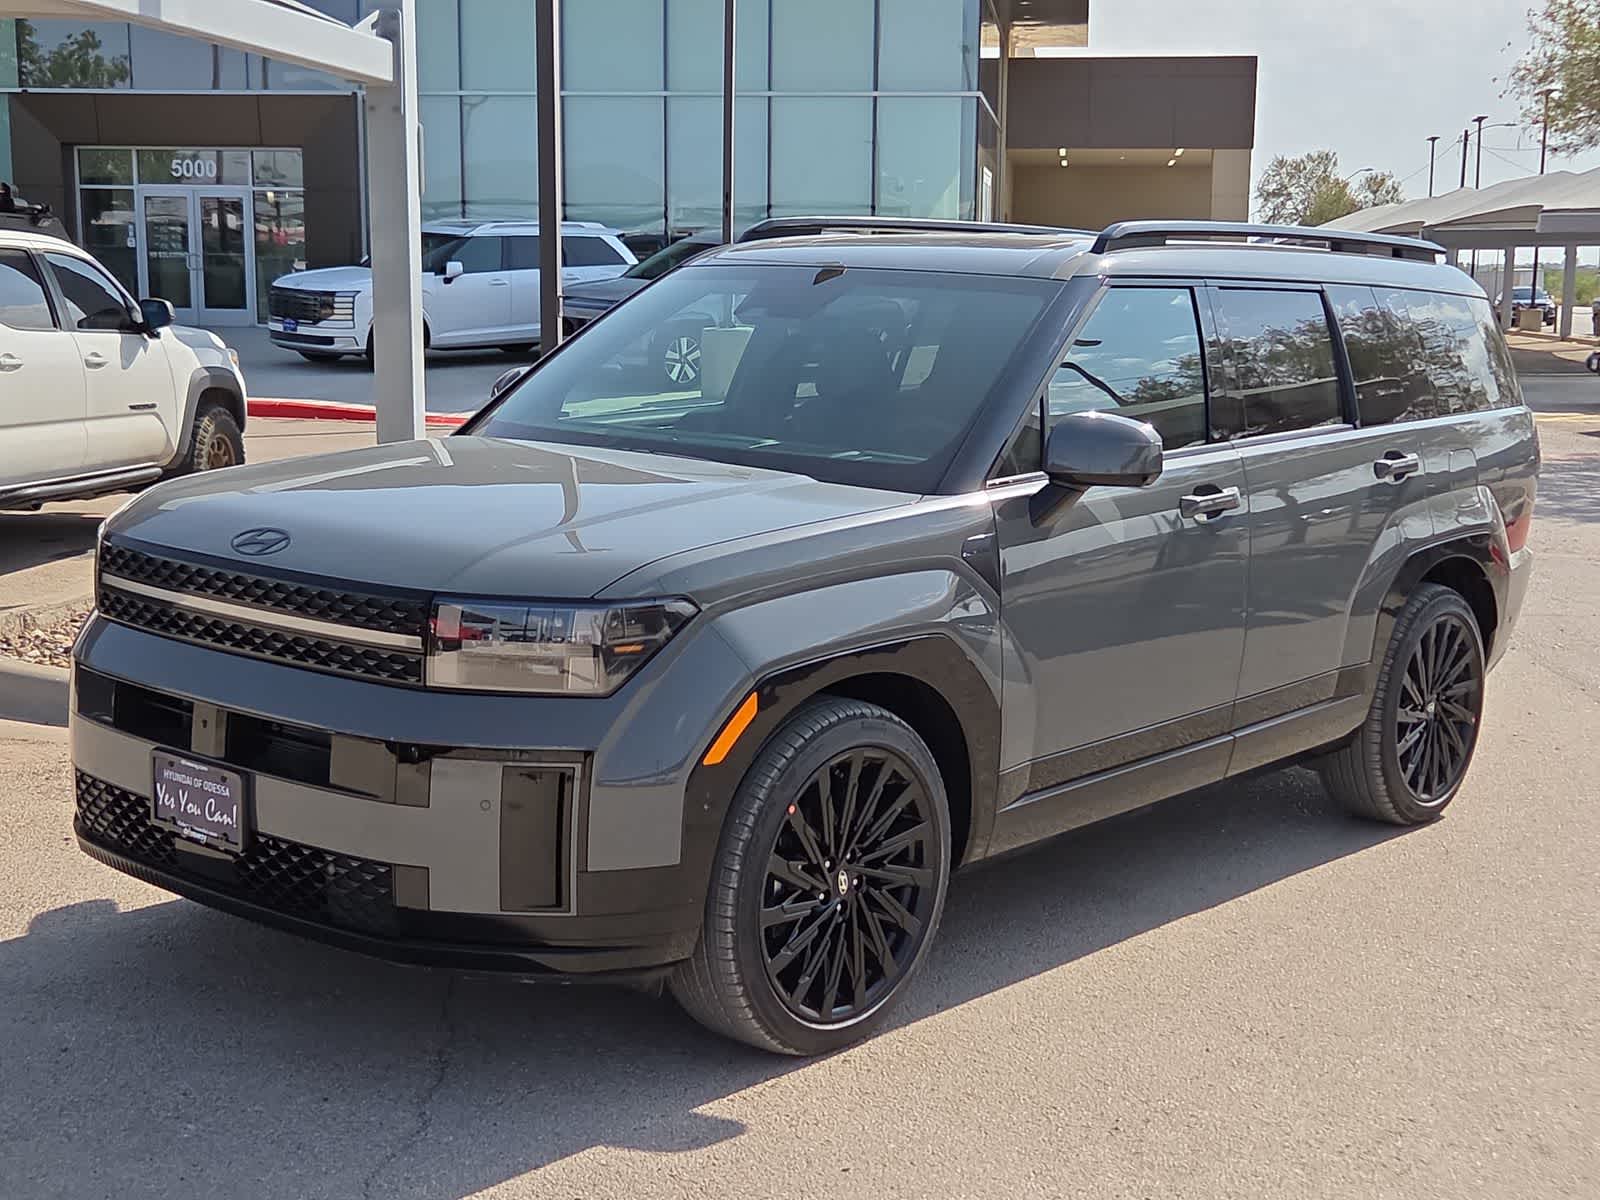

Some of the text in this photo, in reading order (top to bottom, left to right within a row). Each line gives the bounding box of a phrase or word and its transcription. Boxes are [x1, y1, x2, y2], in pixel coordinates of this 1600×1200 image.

[170, 159, 217, 177] 5000
[163, 769, 230, 797] HYUNDAI OF ODESSA
[156, 782, 175, 809] Yes
[179, 788, 201, 816] You
[205, 798, 237, 829] Can!
